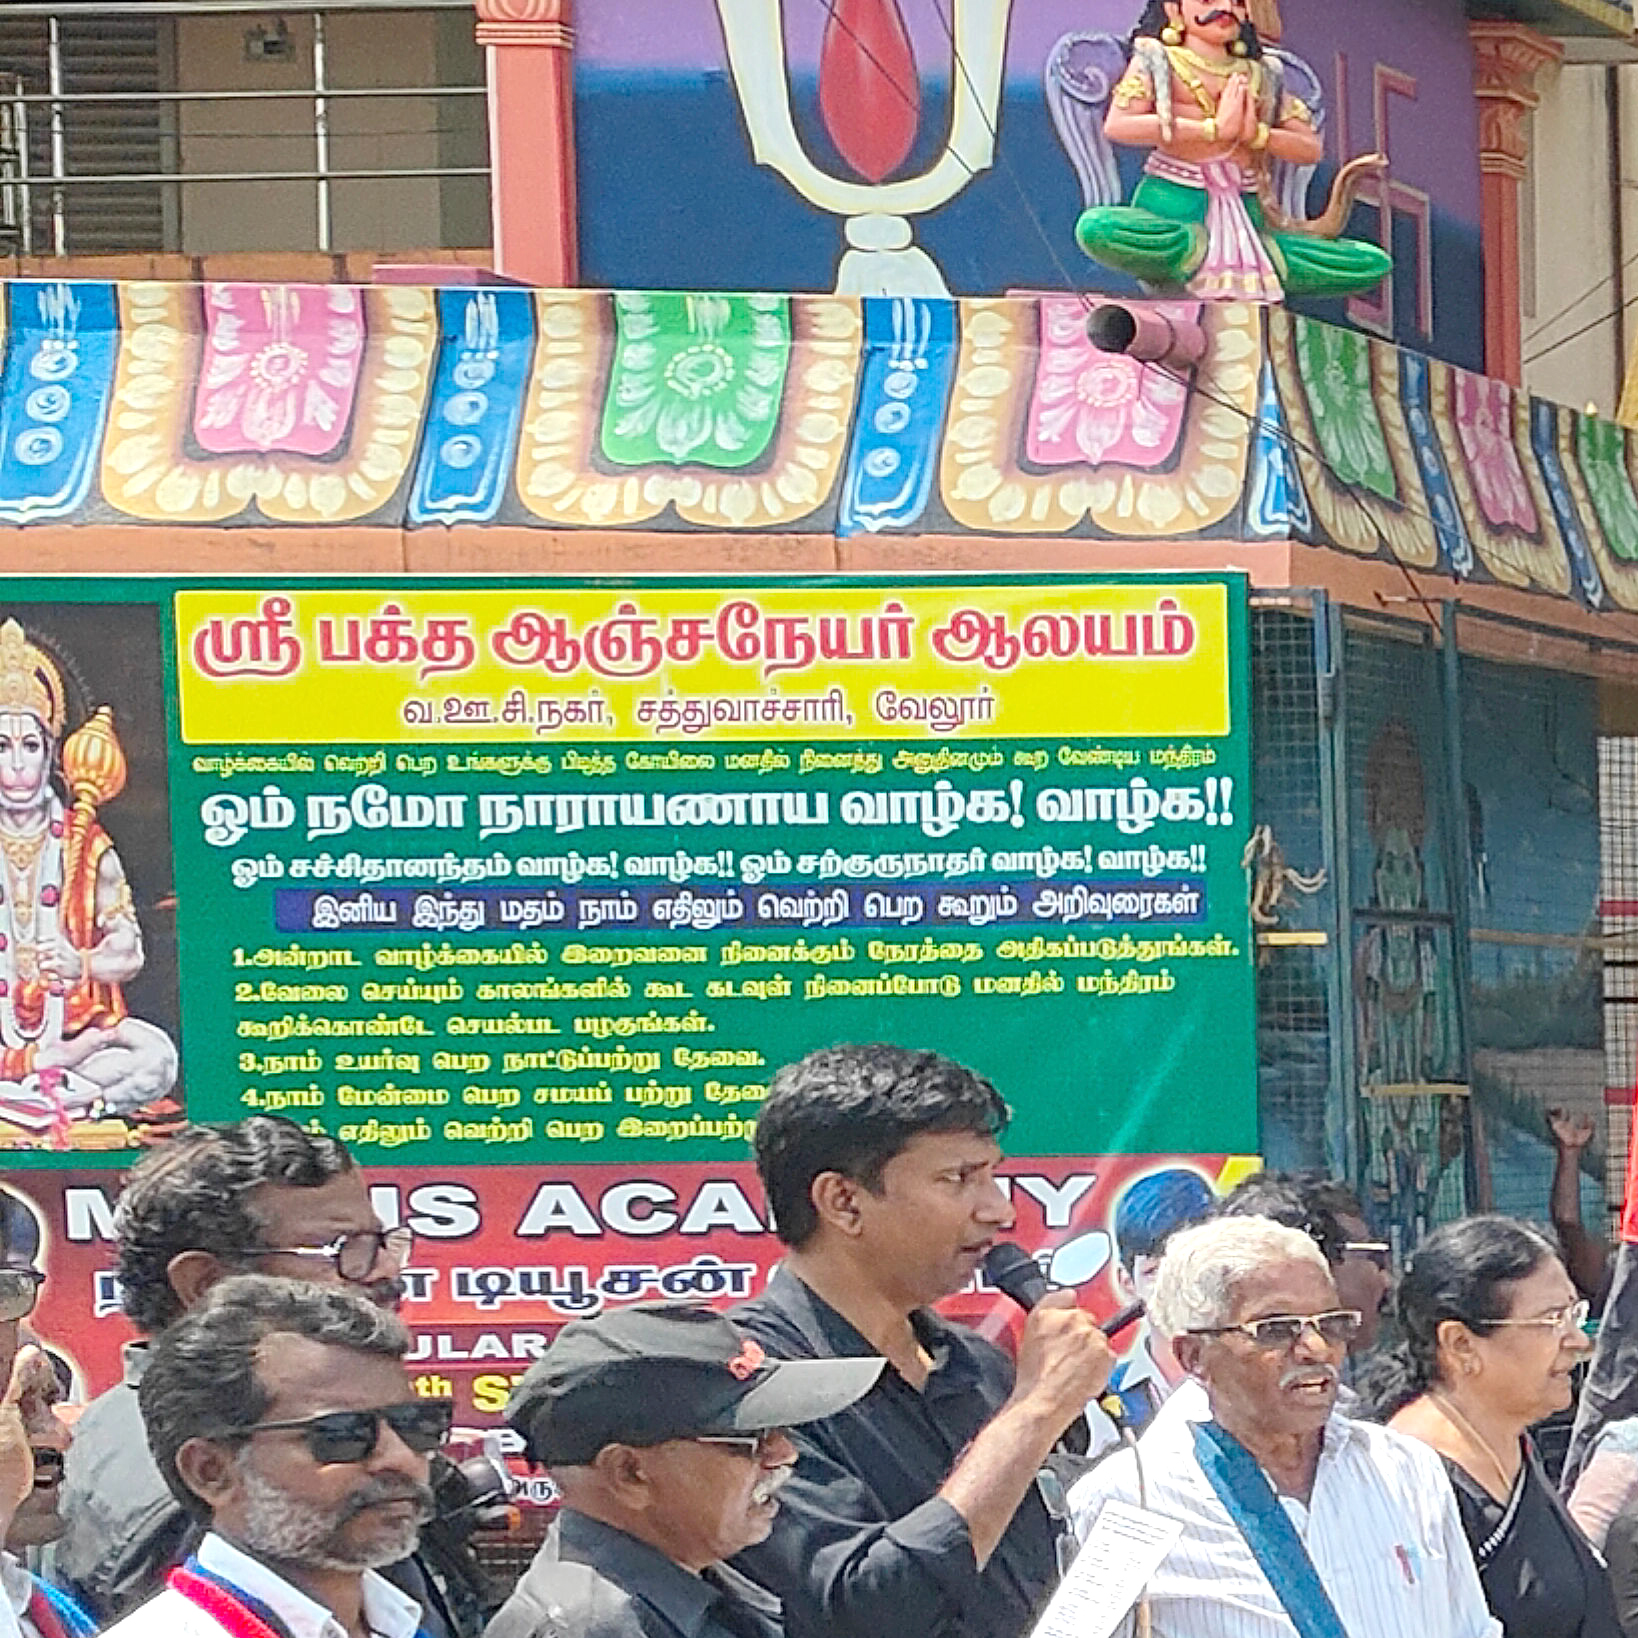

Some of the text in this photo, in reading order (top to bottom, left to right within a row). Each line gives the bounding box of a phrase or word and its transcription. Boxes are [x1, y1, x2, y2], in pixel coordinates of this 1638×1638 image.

[194, 597, 1196, 681] ஸ்ரீ பக்த ஆஞ்சநேயர் ஆலயம்
[637, 687, 853, 735] சத்துவாச்சாரி,
[875, 687, 994, 732] வேலூர்
[201, 777, 1234, 847] ஓம் நமோ நாராயணாய வாழ்க! வாழ்க!!
[231, 855, 284, 888] ஓம்
[288, 852, 512, 885] சச்சிதானந்தம்
[515, 852, 618, 882] வாழ்க!
[623, 849, 734, 882] வாழ்க!!
[740, 850, 791, 883] ஓம்
[991, 846, 1093, 878] வாழ்க!
[1097, 844, 1207, 876] வாழ்க!!
[311, 884, 1200, 931] இனிய இந்து மதம் நாம் எதிலும் வெற்றி பெற கூறும் அறிவுரைகள்
[375, 942, 548, 971] வாழ்க்கையில்
[560, 943, 707, 969] இறைவனை
[720, 938, 855, 965] நினைக்கும்
[867, 937, 984, 964] நேரத்தை
[362, 977, 463, 1004] செய்யும்
[476, 975, 631, 1001] காலங்களில்
[644, 980, 692, 1000] கூட
[705, 973, 792, 1001] கடவுள்
[804, 972, 961, 999] நினைப்போடு
[973, 971, 1064, 996] மனதில்
[1076, 968, 1176, 995] மந்திரம்
[446, 1012, 561, 1036] செயல்பட
[334, 1047, 421, 1074] உயர்வு
[432, 1050, 491, 1073] பெற
[673, 1047, 766, 1068] தேவை.
[338, 1082, 450, 1106] மேன்மை
[463, 1085, 521, 1108] பெற
[624, 1080, 693, 1107] பற்று
[338, 1116, 432, 1146] எதிலும்
[444, 1116, 533, 1142] வெற்றி
[545, 1119, 605, 1142] பெற
